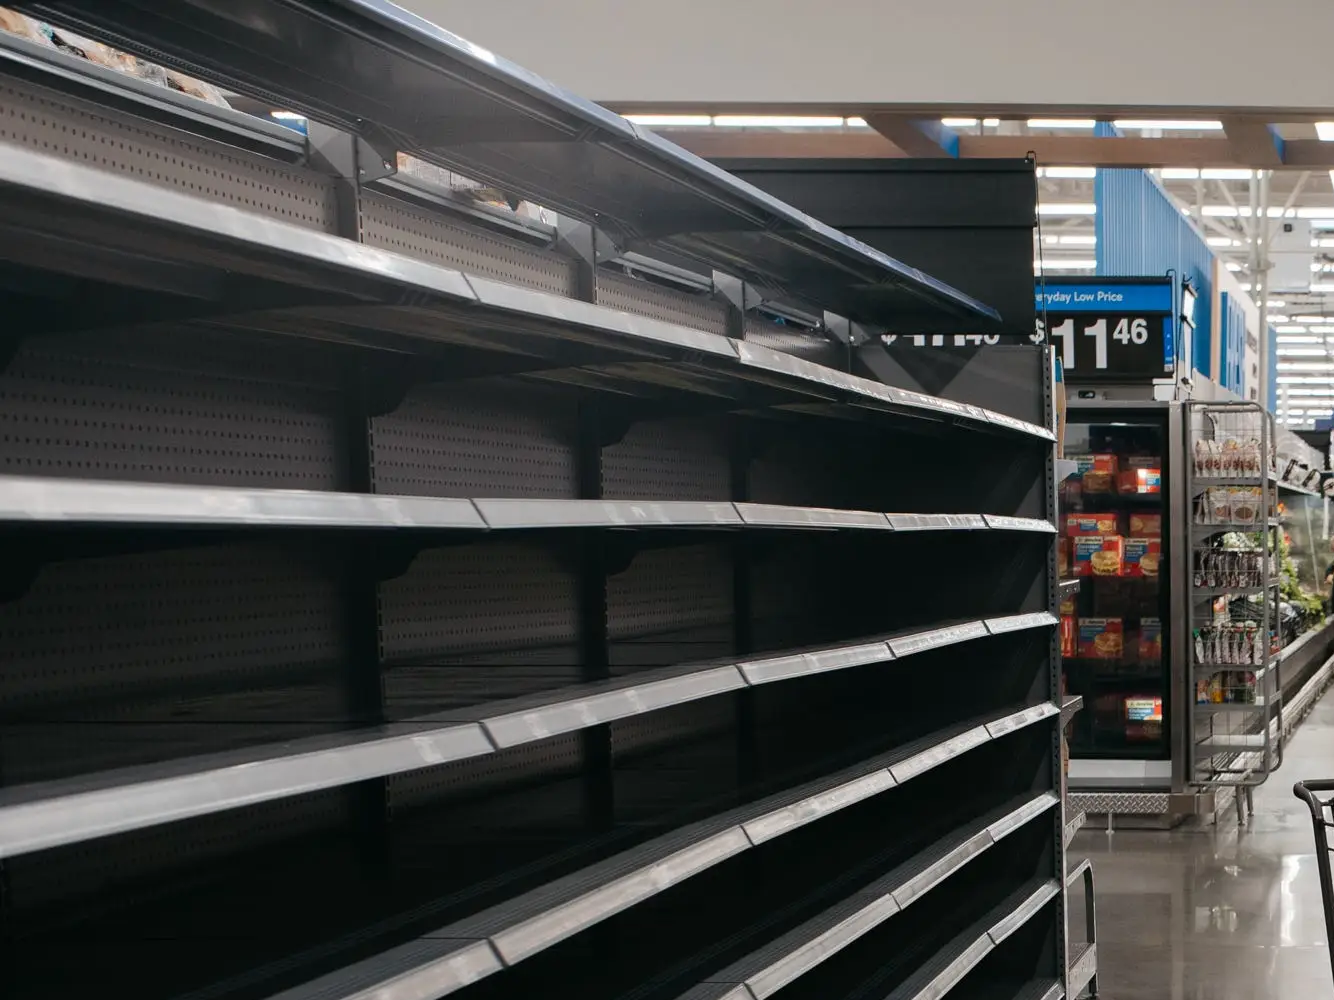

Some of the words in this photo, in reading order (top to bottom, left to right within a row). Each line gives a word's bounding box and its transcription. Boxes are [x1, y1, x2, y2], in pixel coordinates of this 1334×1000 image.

[1035, 291, 1072, 304] eryday
[1074, 291, 1094, 302] Low
[1097, 291, 1123, 302] Price
